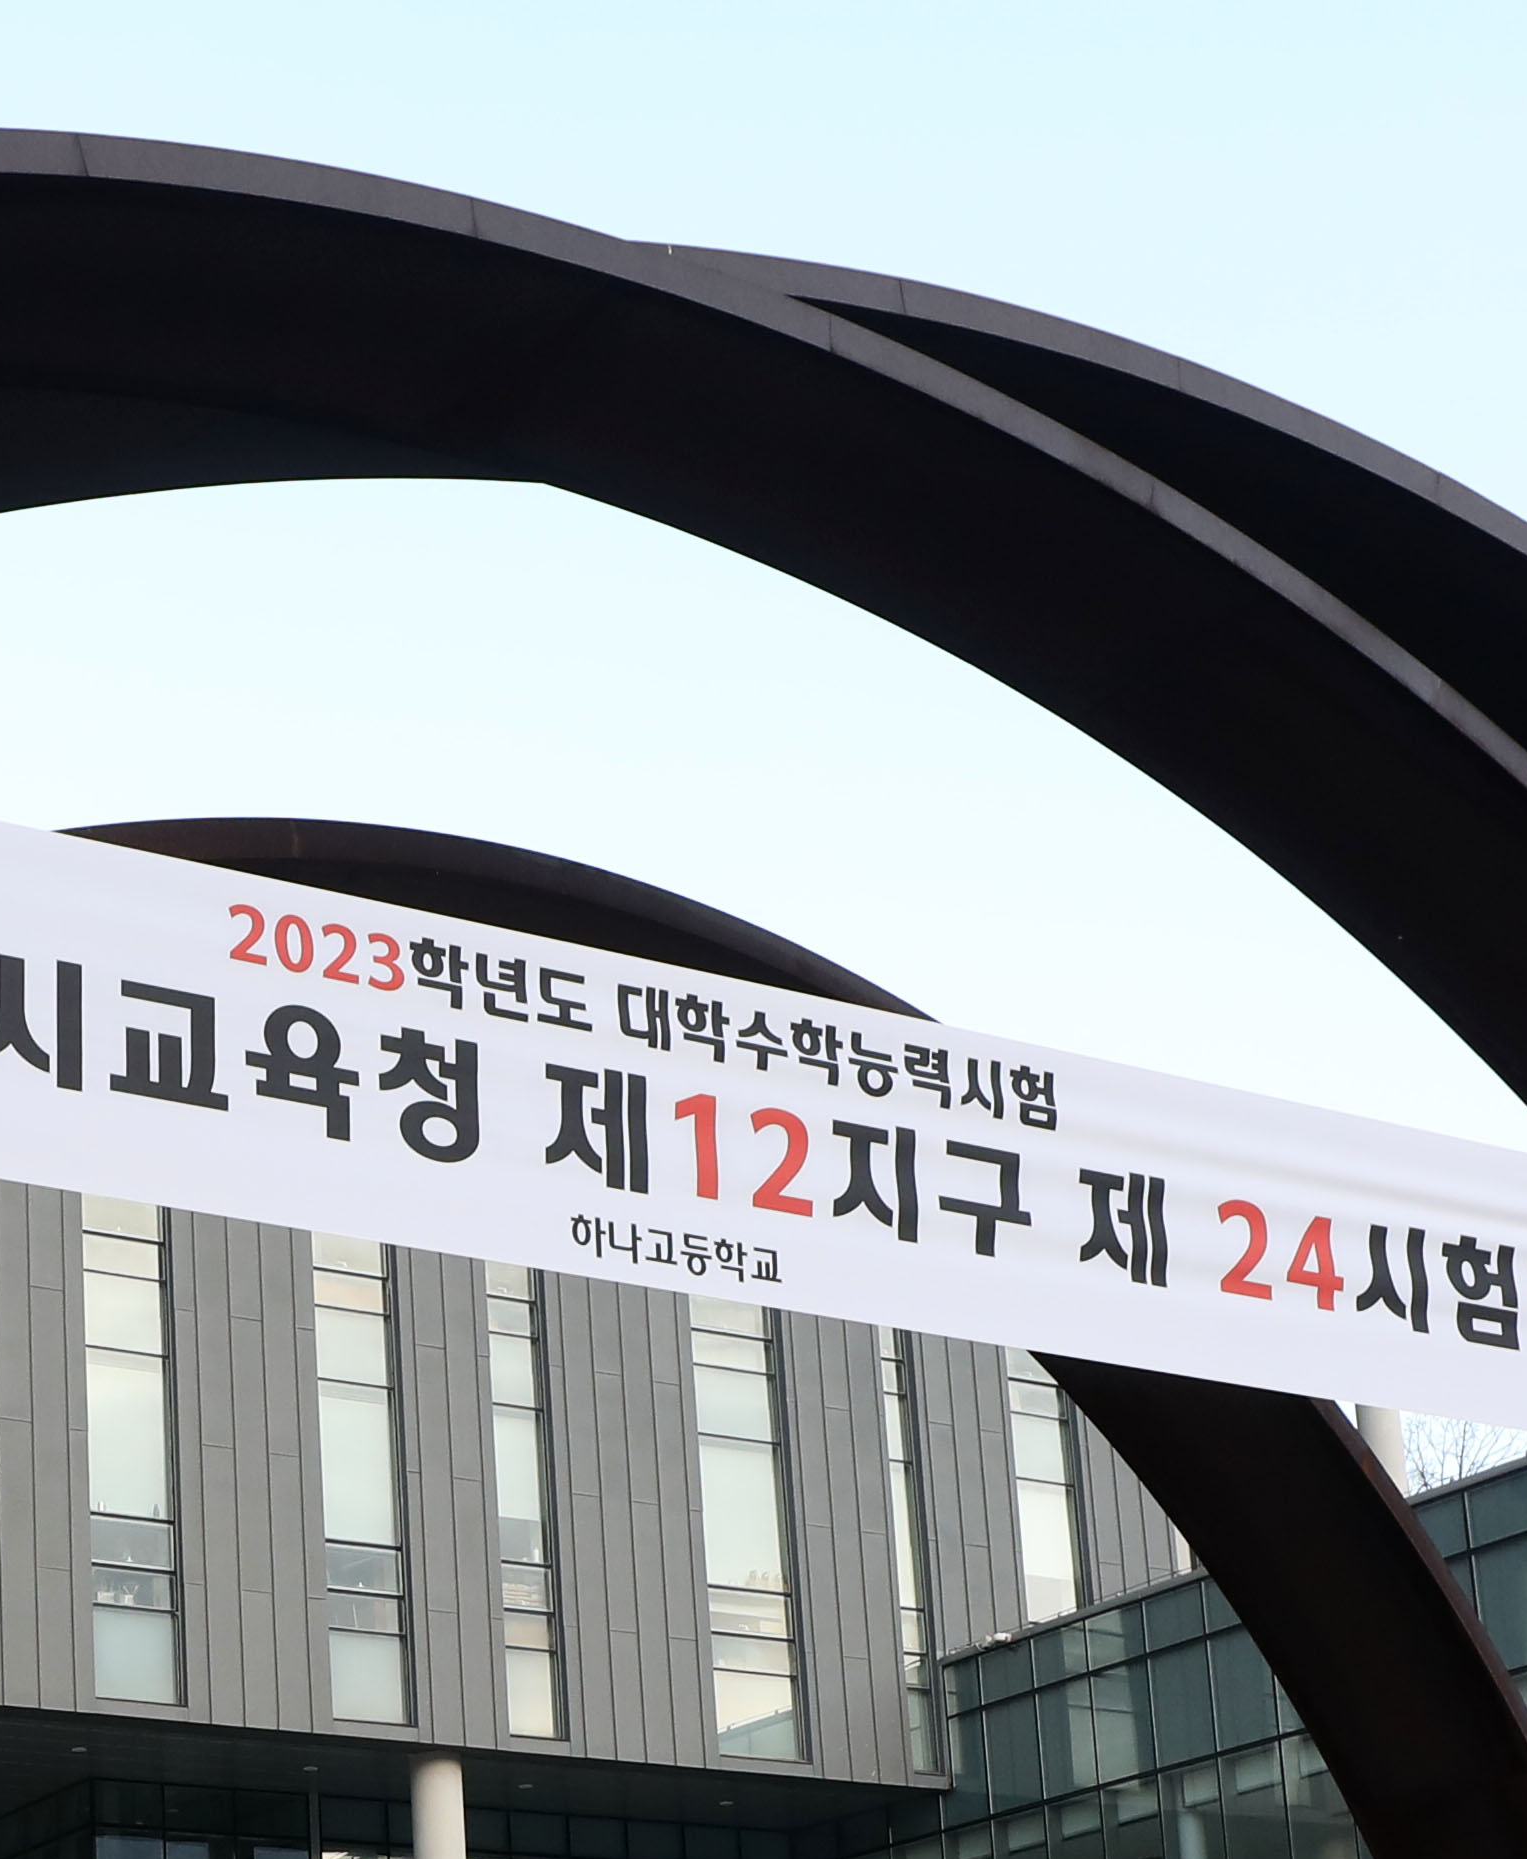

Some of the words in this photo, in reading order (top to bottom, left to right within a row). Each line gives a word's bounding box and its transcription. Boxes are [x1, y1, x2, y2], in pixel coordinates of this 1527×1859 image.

[229, 905, 592, 1032] 2023학년도
[618, 984, 1057, 1131] 대학수학능력시험
[546, 1063, 1031, 1257] 제12지구
[1079, 1169, 1168, 1287] 제
[570, 1205, 782, 1283] 하나고등학교
